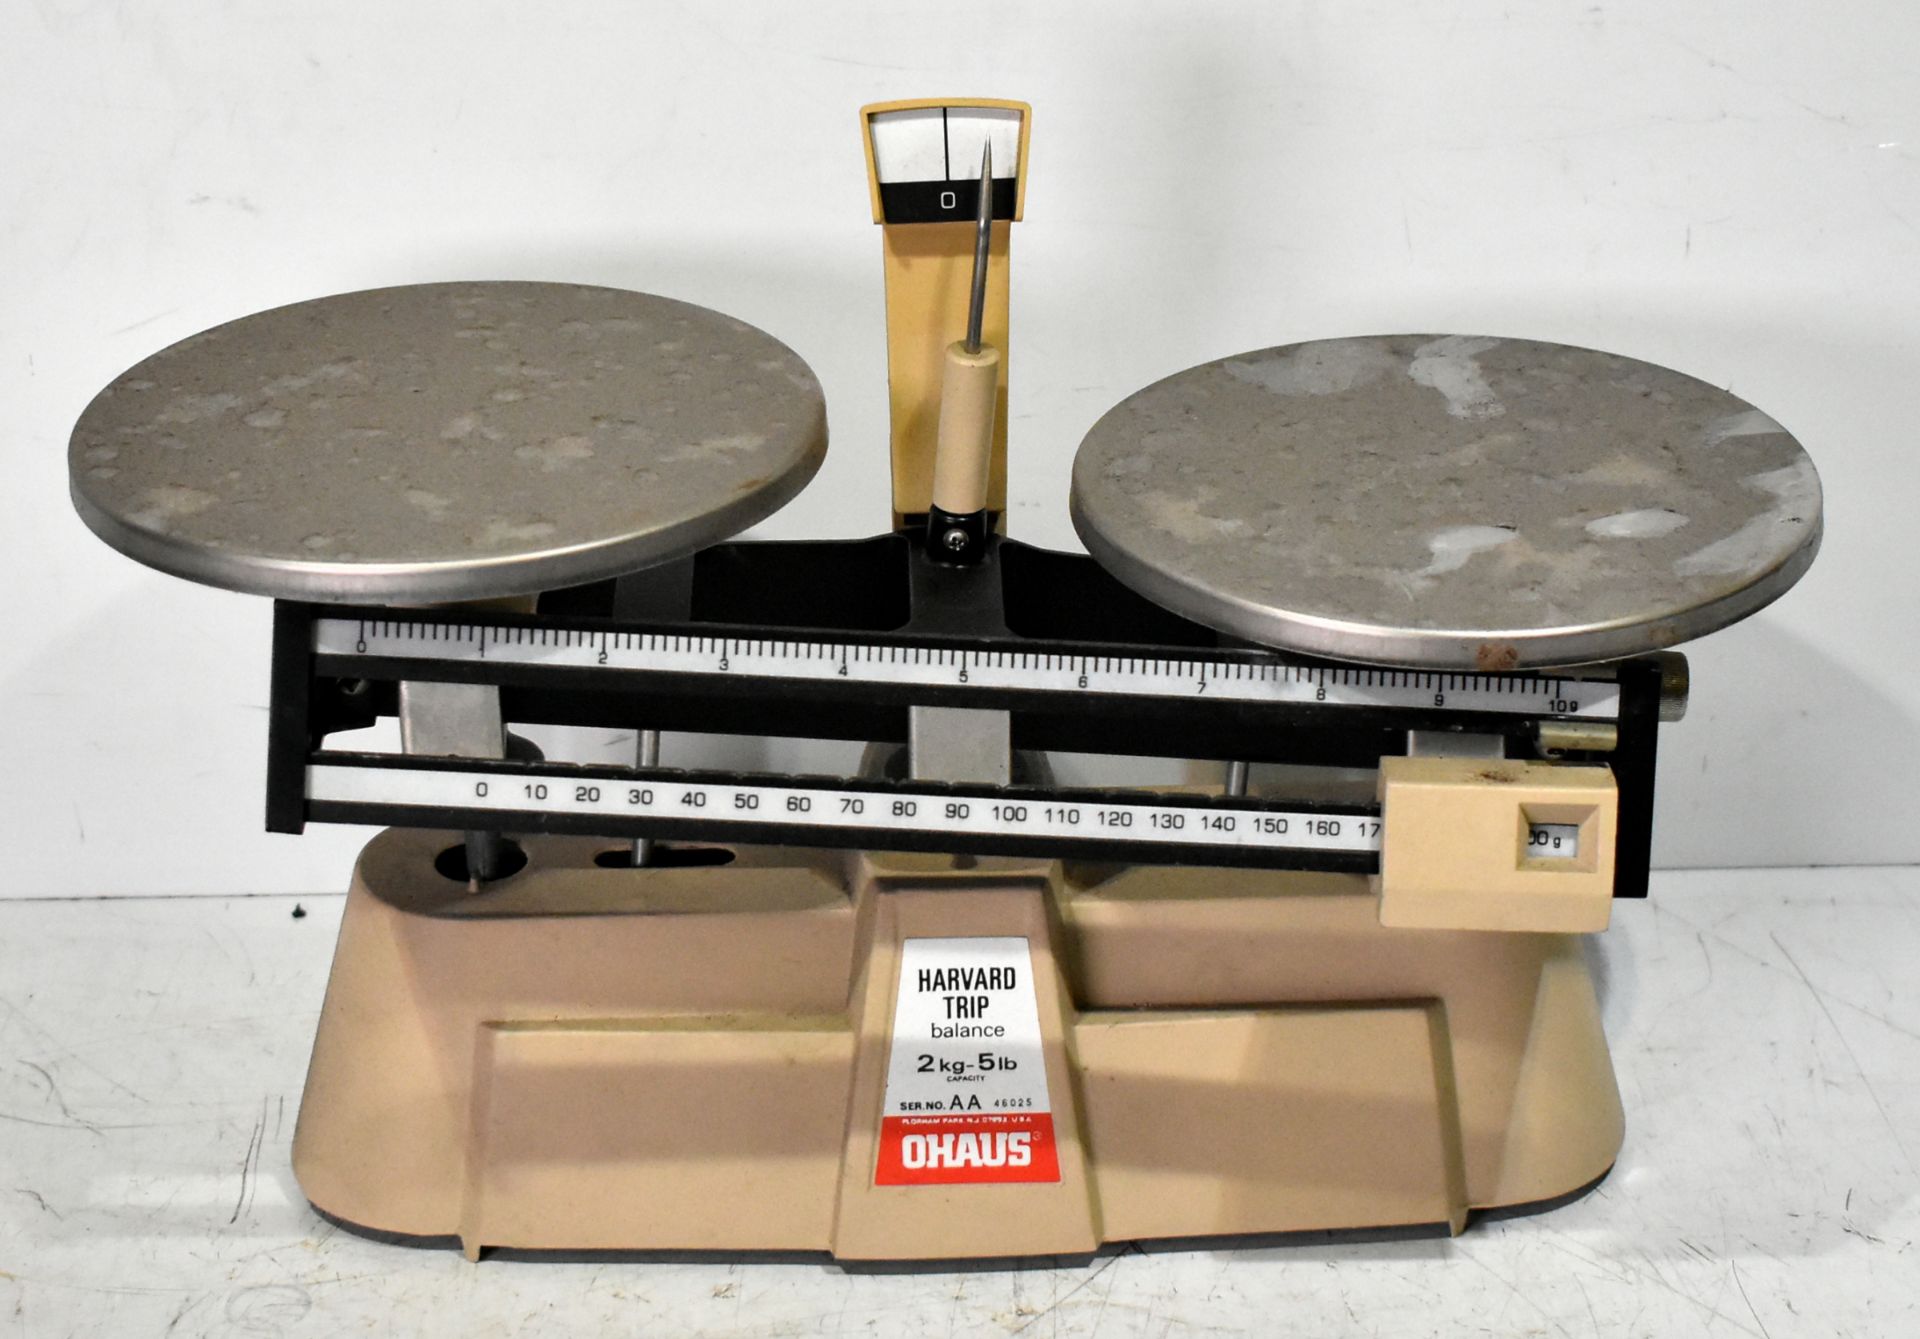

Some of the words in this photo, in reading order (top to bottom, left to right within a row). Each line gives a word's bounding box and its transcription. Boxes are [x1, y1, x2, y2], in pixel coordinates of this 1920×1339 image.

[941, 192, 956, 209] 0
[357, 640, 367, 653] 0
[597, 652, 609, 665] 2
[719, 658, 729, 671] 3
[838, 662, 849, 676] 4
[959, 669, 969, 683] 5
[1078, 674, 1088, 689] 6
[1197, 682, 1207, 694] 7
[1316, 687, 1326, 701] 8
[1434, 693, 1444, 707] 9
[476, 782, 488, 798] 0
[524, 784, 548, 800] 10
[575, 786, 601, 802] 20
[628, 789, 654, 805] 30
[680, 791, 707, 808] 40
[734, 793, 759, 810] 50
[786, 796, 811, 813] 60
[839, 798, 864, 815] 70
[891, 801, 917, 817] 80
[945, 803, 970, 819] 90
[991, 806, 1028, 822] 100
[1044, 808, 1080, 824] 110
[1097, 811, 1133, 827] 120
[1150, 813, 1185, 829] 130
[1201, 815, 1236, 832] 140
[1253, 818, 1288, 834] 150
[1305, 820, 1341, 836] 160
[1553, 837, 1561, 849] g
[918, 967, 1016, 992] HARVARD
[943, 996, 989, 1019] TRIP
[931, 1022, 1005, 1039] balance
[994, 1098, 1033, 1107] 46025
[902, 1132, 1031, 1169] OHAUS
